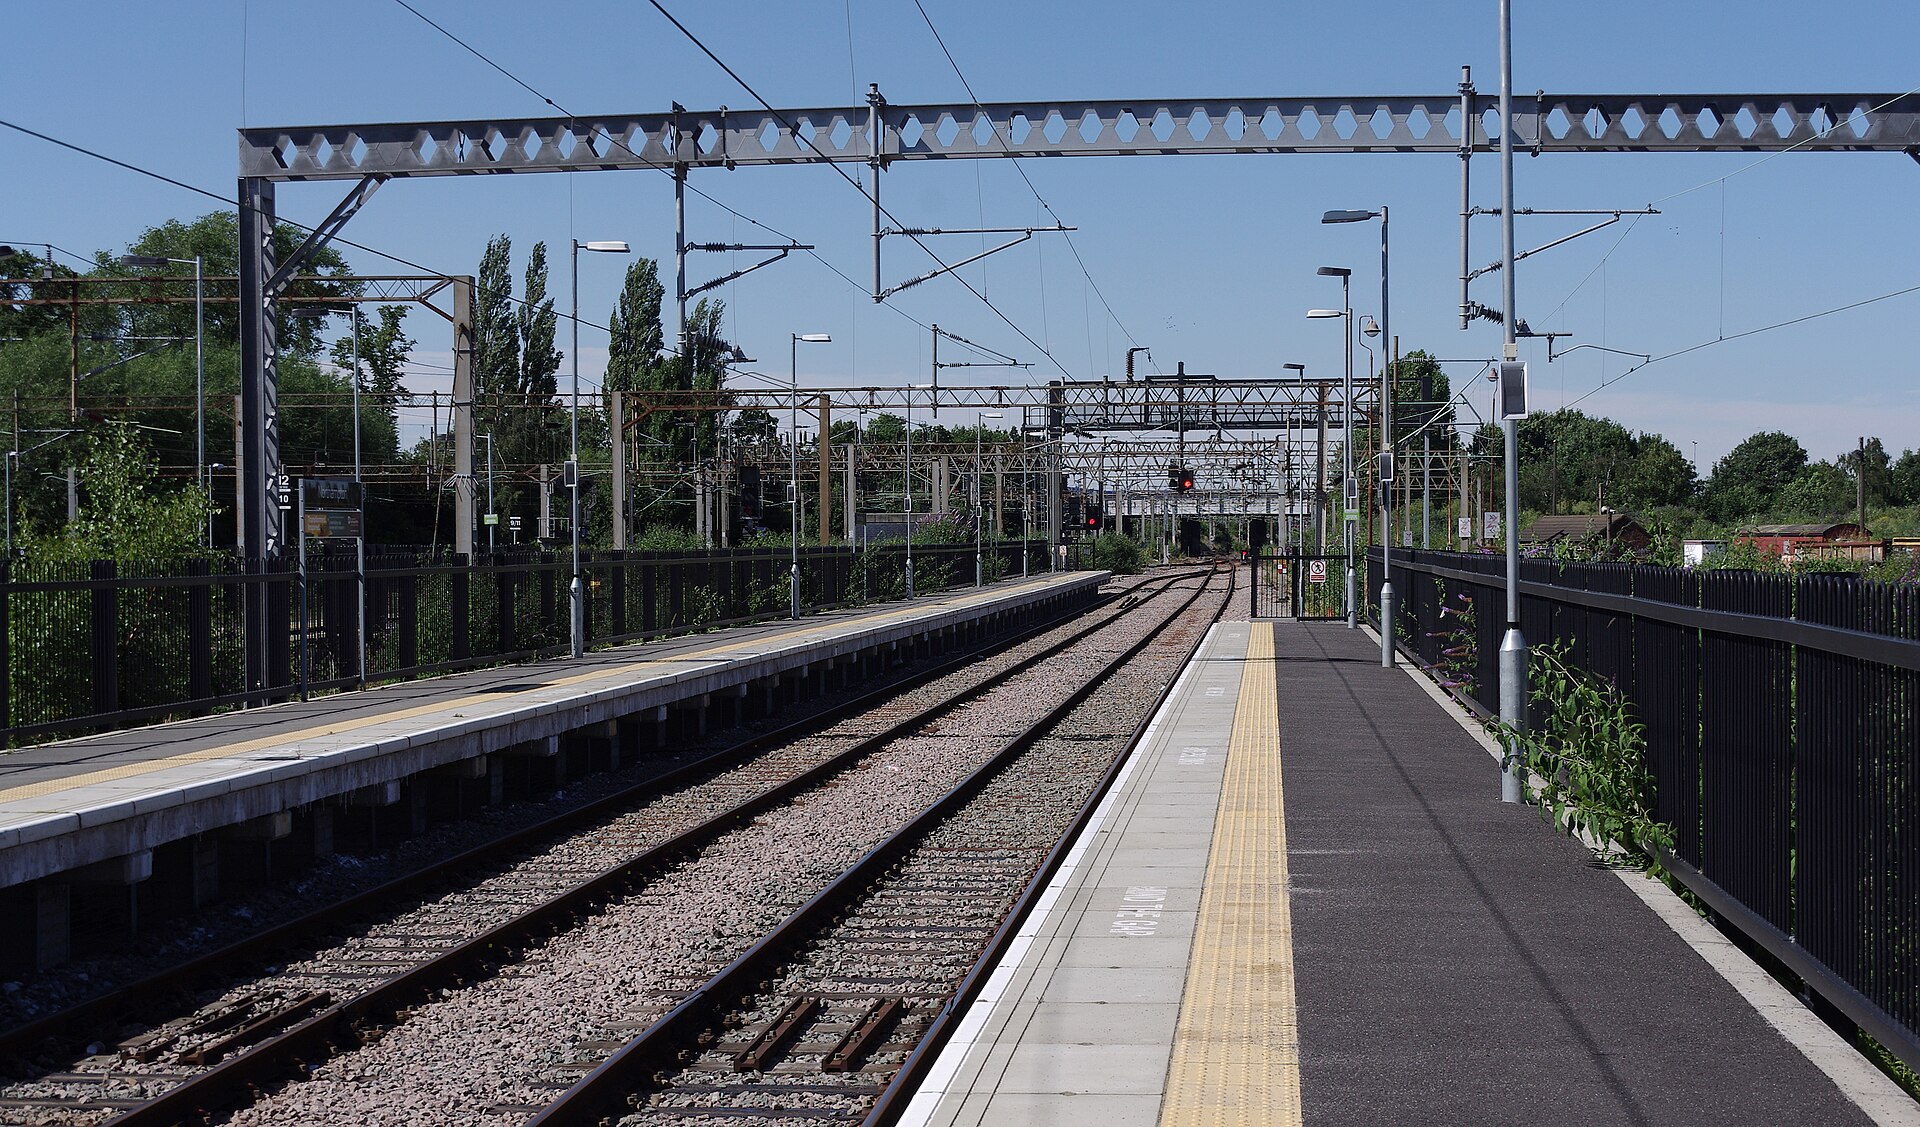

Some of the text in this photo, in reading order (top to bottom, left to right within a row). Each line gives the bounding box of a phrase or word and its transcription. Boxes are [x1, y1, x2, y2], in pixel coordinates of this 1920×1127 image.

[279, 475, 289, 485] 12
[279, 495, 289, 503] 10
[1116, 904, 1164, 918] THE
[1109, 920, 1158, 936] GAP
